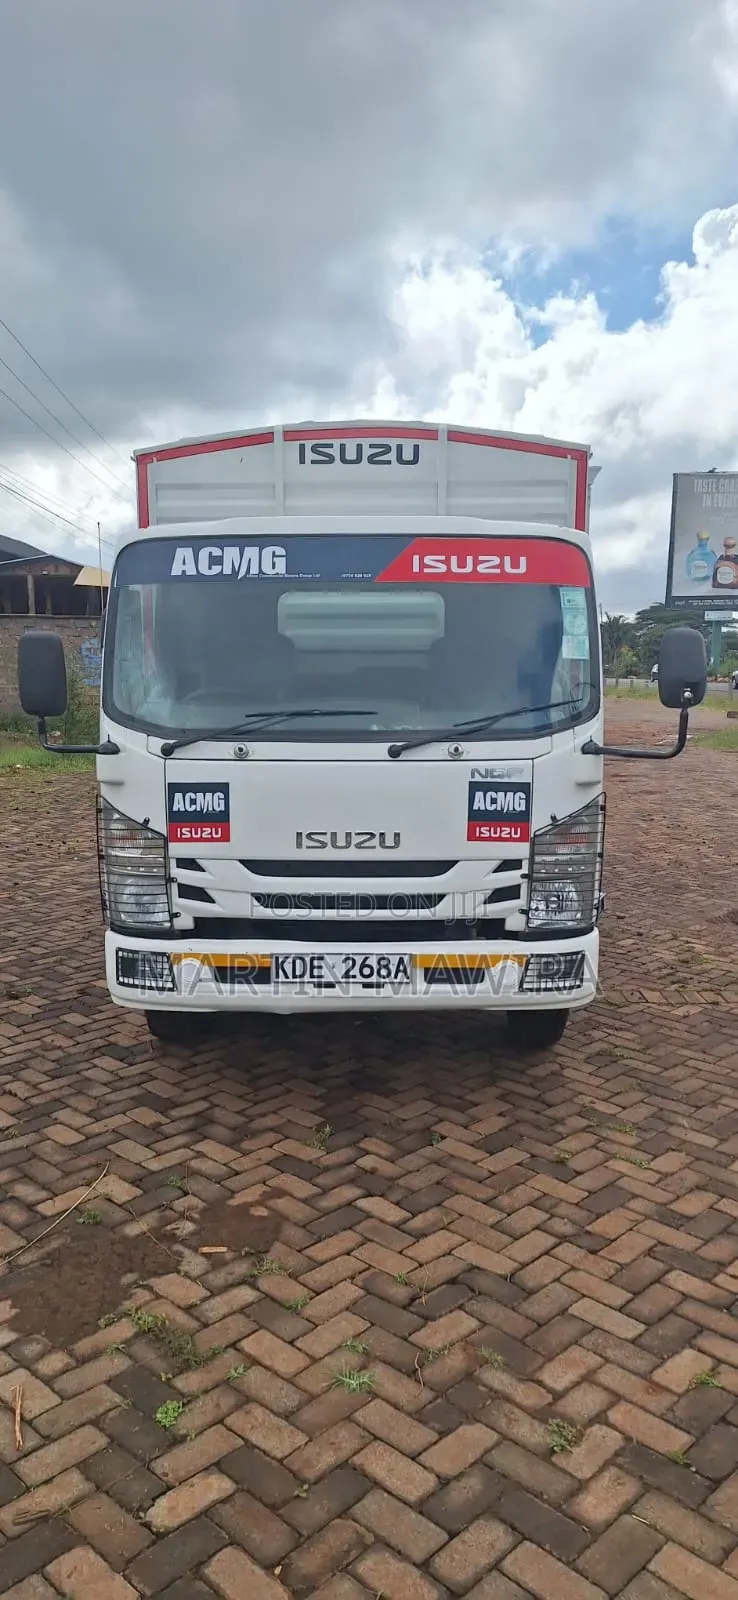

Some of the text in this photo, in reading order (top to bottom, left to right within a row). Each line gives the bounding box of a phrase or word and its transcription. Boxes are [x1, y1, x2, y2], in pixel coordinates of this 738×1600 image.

[299, 443, 420, 466] ISUZU
[694, 478, 717, 493] TASTE
[702, 493, 712, 508] IN
[171, 545, 287, 580] ACMG
[412, 554, 527, 574] ISUZU
[172, 792, 225, 814] ACMG
[472, 791, 526, 814] ACMG
[177, 827, 222, 839] ISUZU
[296, 831, 401, 850] ISUZU
[475, 827, 521, 838] ISUZU
[273, 955, 410, 980] KDE 268A
